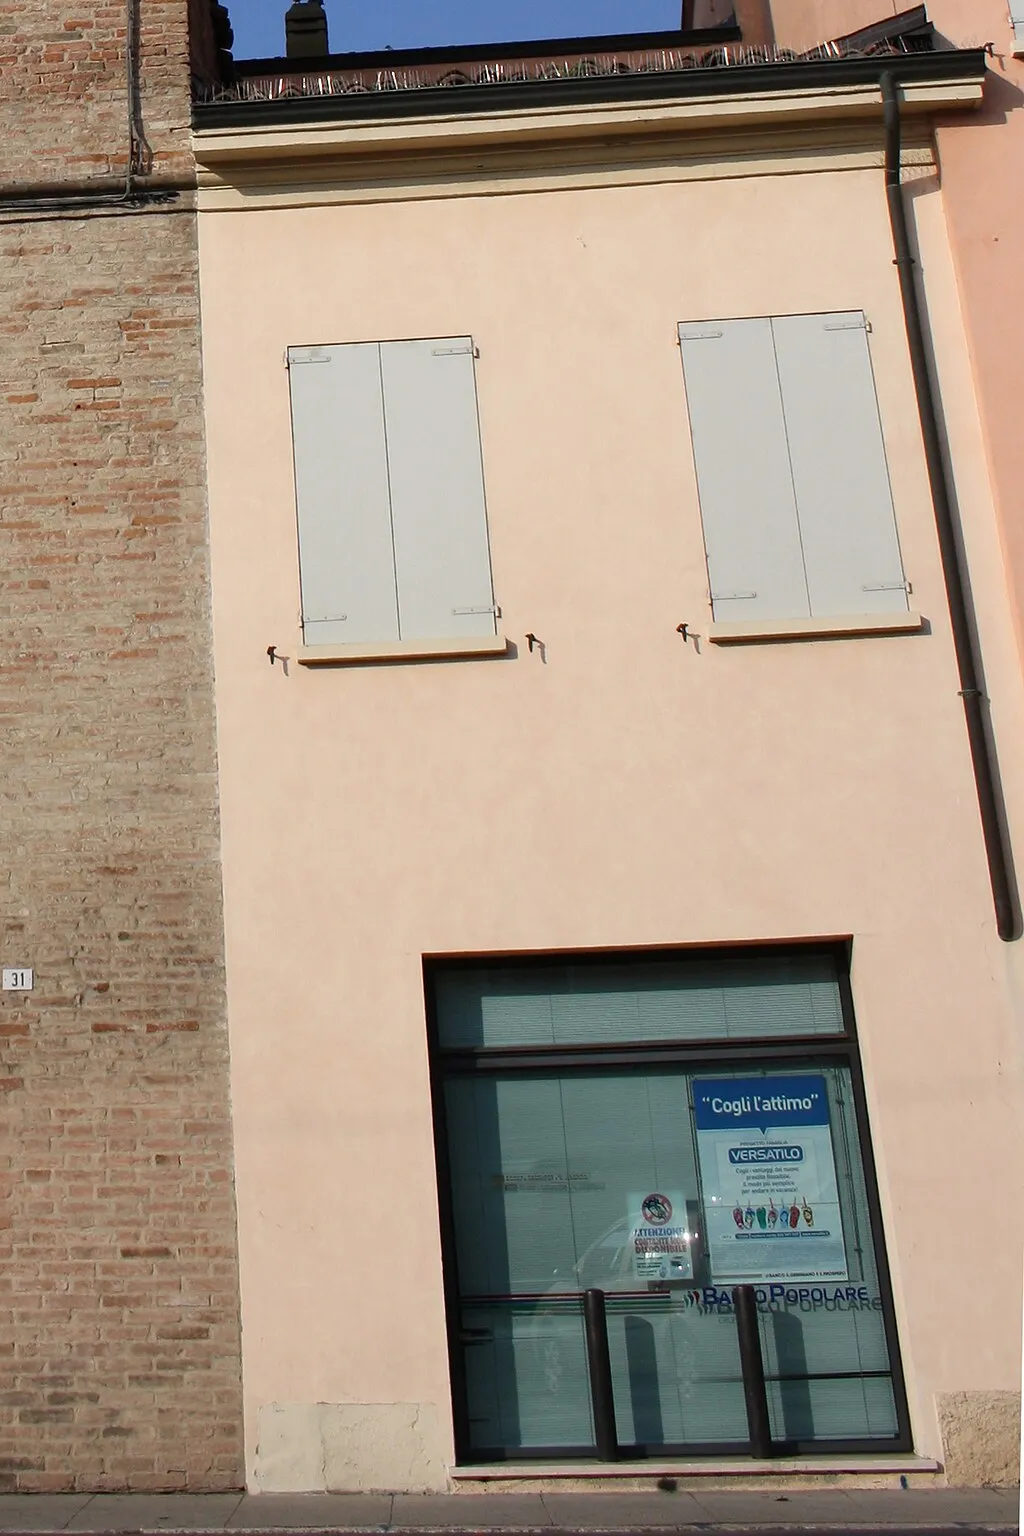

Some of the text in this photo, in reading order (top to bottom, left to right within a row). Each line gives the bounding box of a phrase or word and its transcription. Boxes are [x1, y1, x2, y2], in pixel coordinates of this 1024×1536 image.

[11, 972, 25, 987] 31
[731, 1148, 800, 1161] VERSATILO
[703, 1286, 767, 1305] BAO
